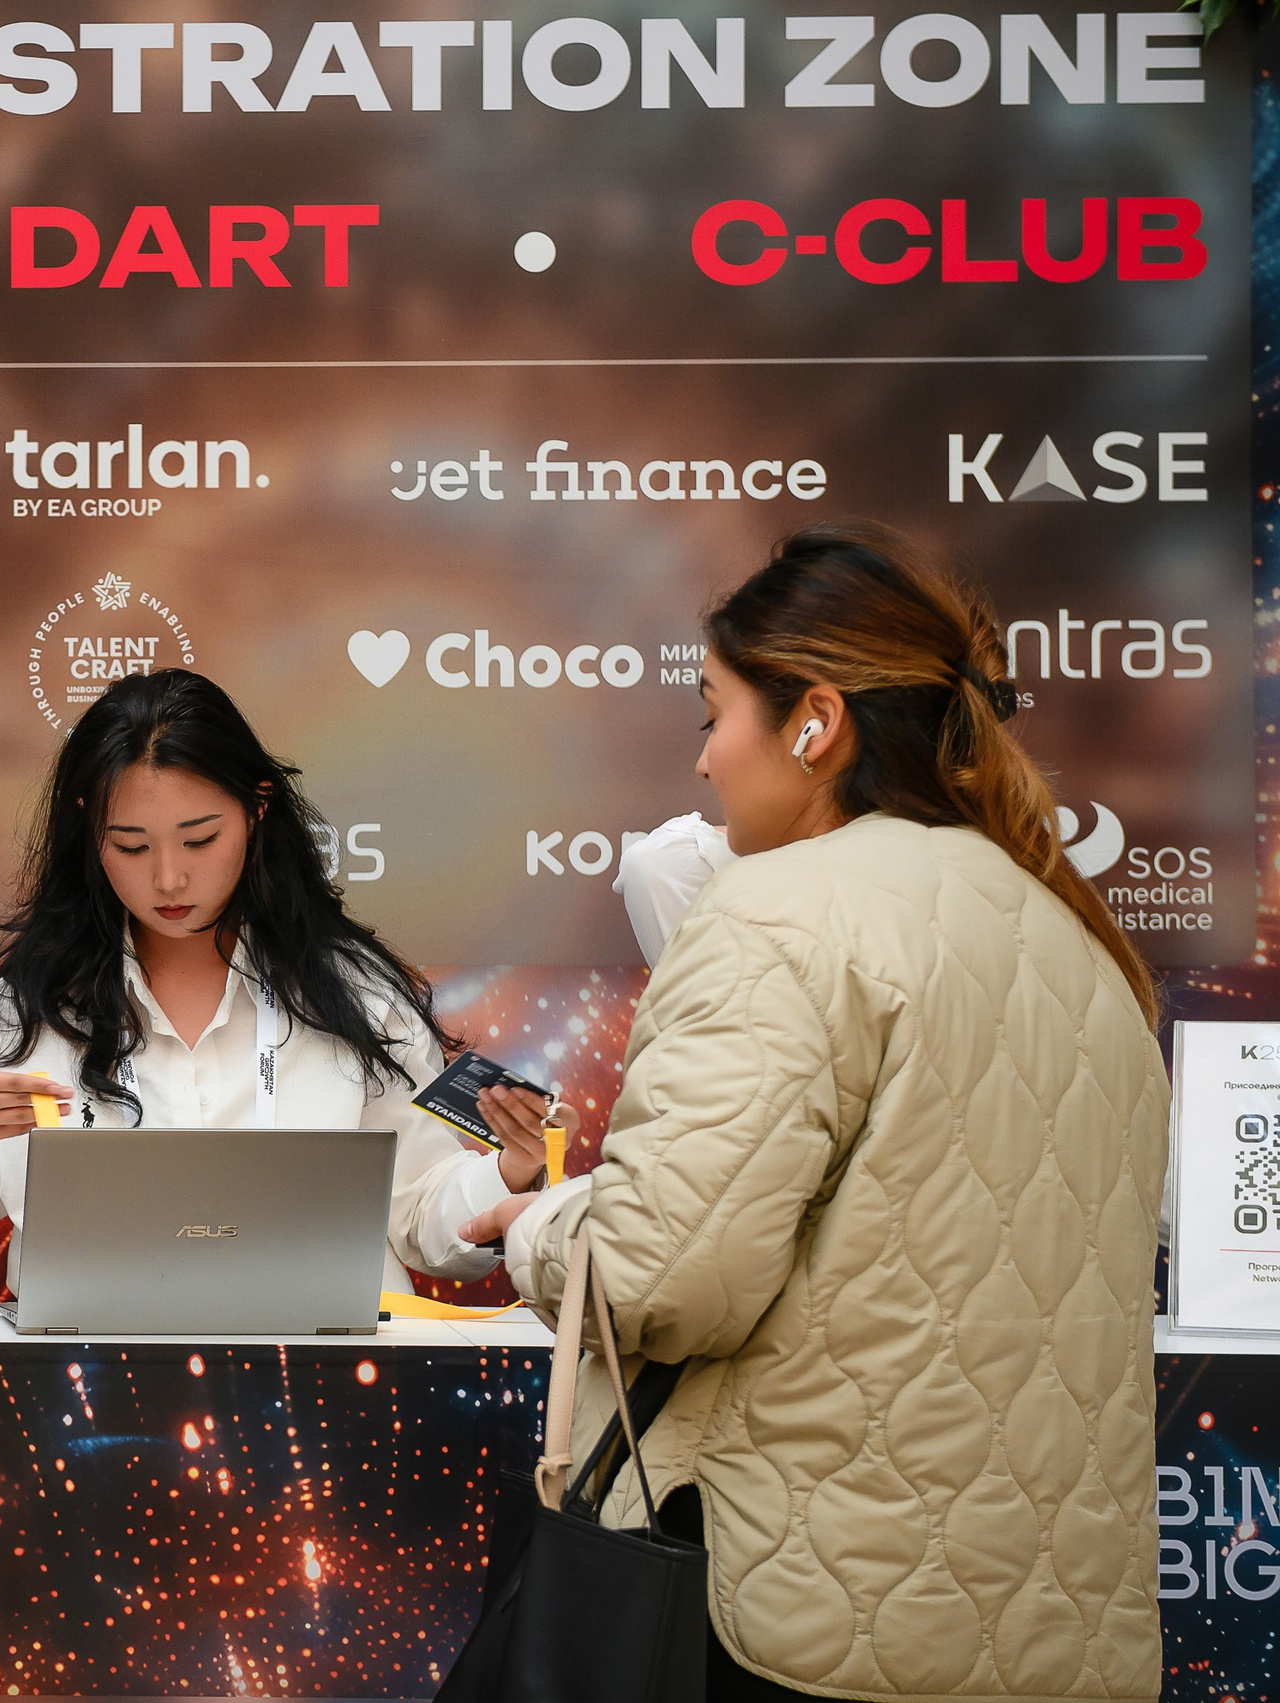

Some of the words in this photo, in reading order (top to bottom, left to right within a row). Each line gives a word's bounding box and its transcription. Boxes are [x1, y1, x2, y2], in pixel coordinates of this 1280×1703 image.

[783, 12, 1206, 108] ZONE
[691, 197, 1209, 287] C-CLUB
[525, 440, 827, 501] finance
[13, 499, 42, 517] BY
[47, 499, 77, 517] EA
[81, 498, 162, 517] GROUP
[35, 592, 85, 642] PEOPLE
[138, 592, 195, 665] ENABLING
[63, 637, 160, 657] TALENT
[426, 629, 645, 688] Choco
[1006, 608, 1213, 680] ntras
[70, 659, 154, 679] CRAFT
[28, 648, 62, 730] THROUGH
[66, 695, 100, 703] BUSINE
[1127, 847, 1213, 879] SOS
[1108, 882, 1213, 905] medical
[1117, 908, 1213, 931] istance
[426, 1101, 488, 1136] STANDARD
[176, 1225, 238, 1238] ASUS
[1248, 1262, 1280, 1271] Прогр
[1253, 1274, 1280, 1282] Netw
